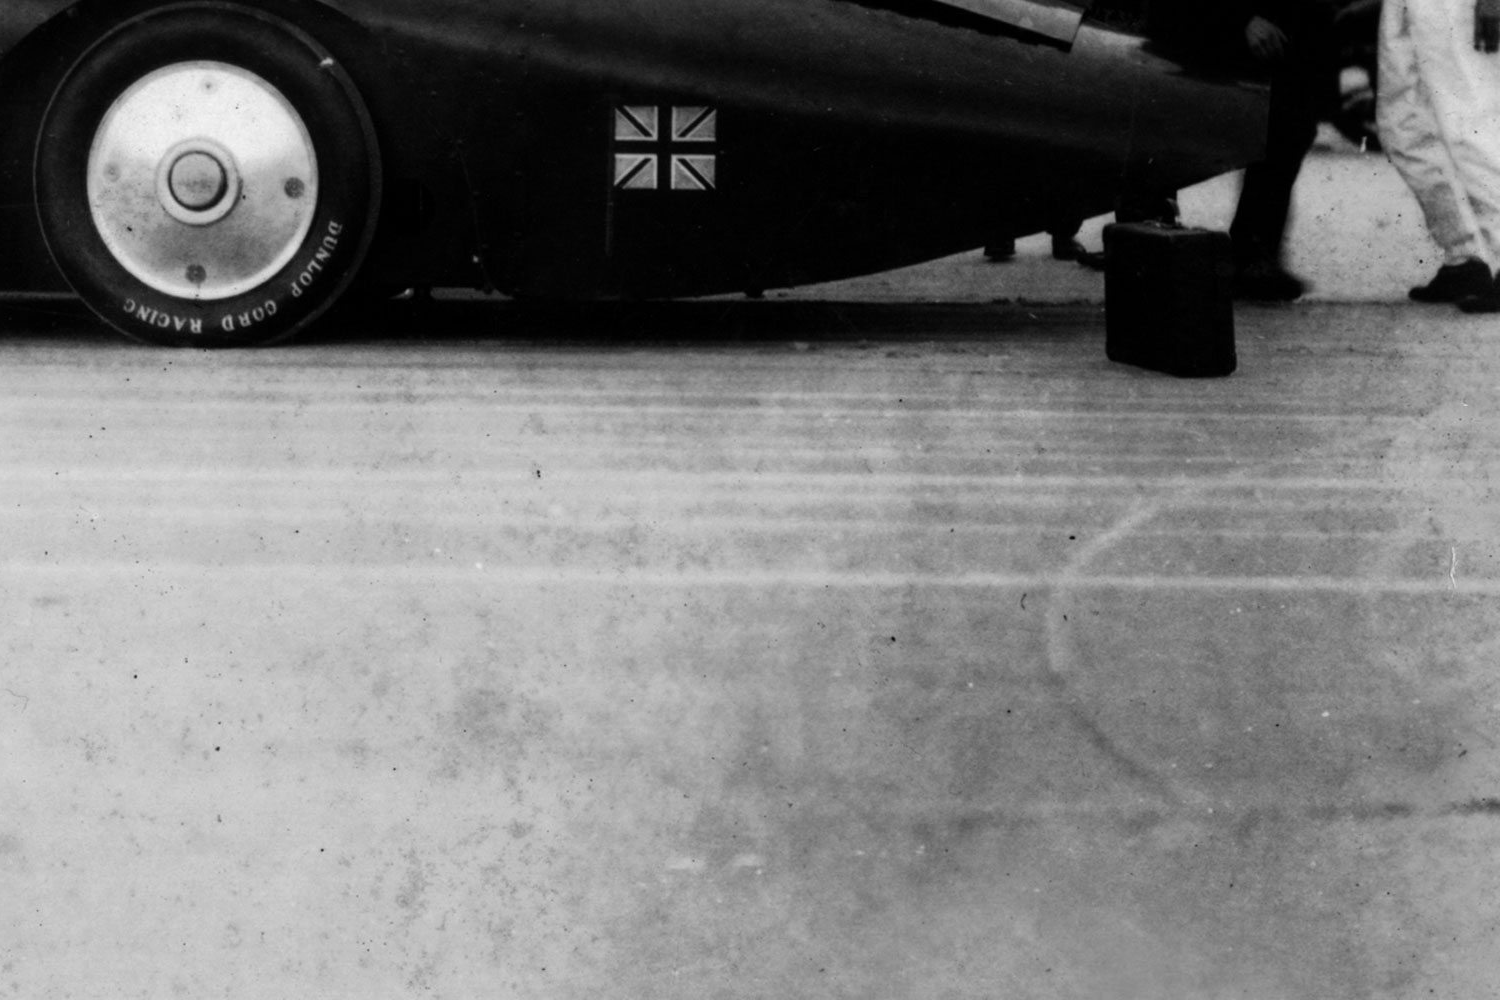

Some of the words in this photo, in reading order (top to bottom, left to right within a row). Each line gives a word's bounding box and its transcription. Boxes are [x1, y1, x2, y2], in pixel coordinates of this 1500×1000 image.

[290, 220, 343, 299] DUNLOP
[122, 297, 203, 335] RACING
[220, 298, 279, 333] CORD
